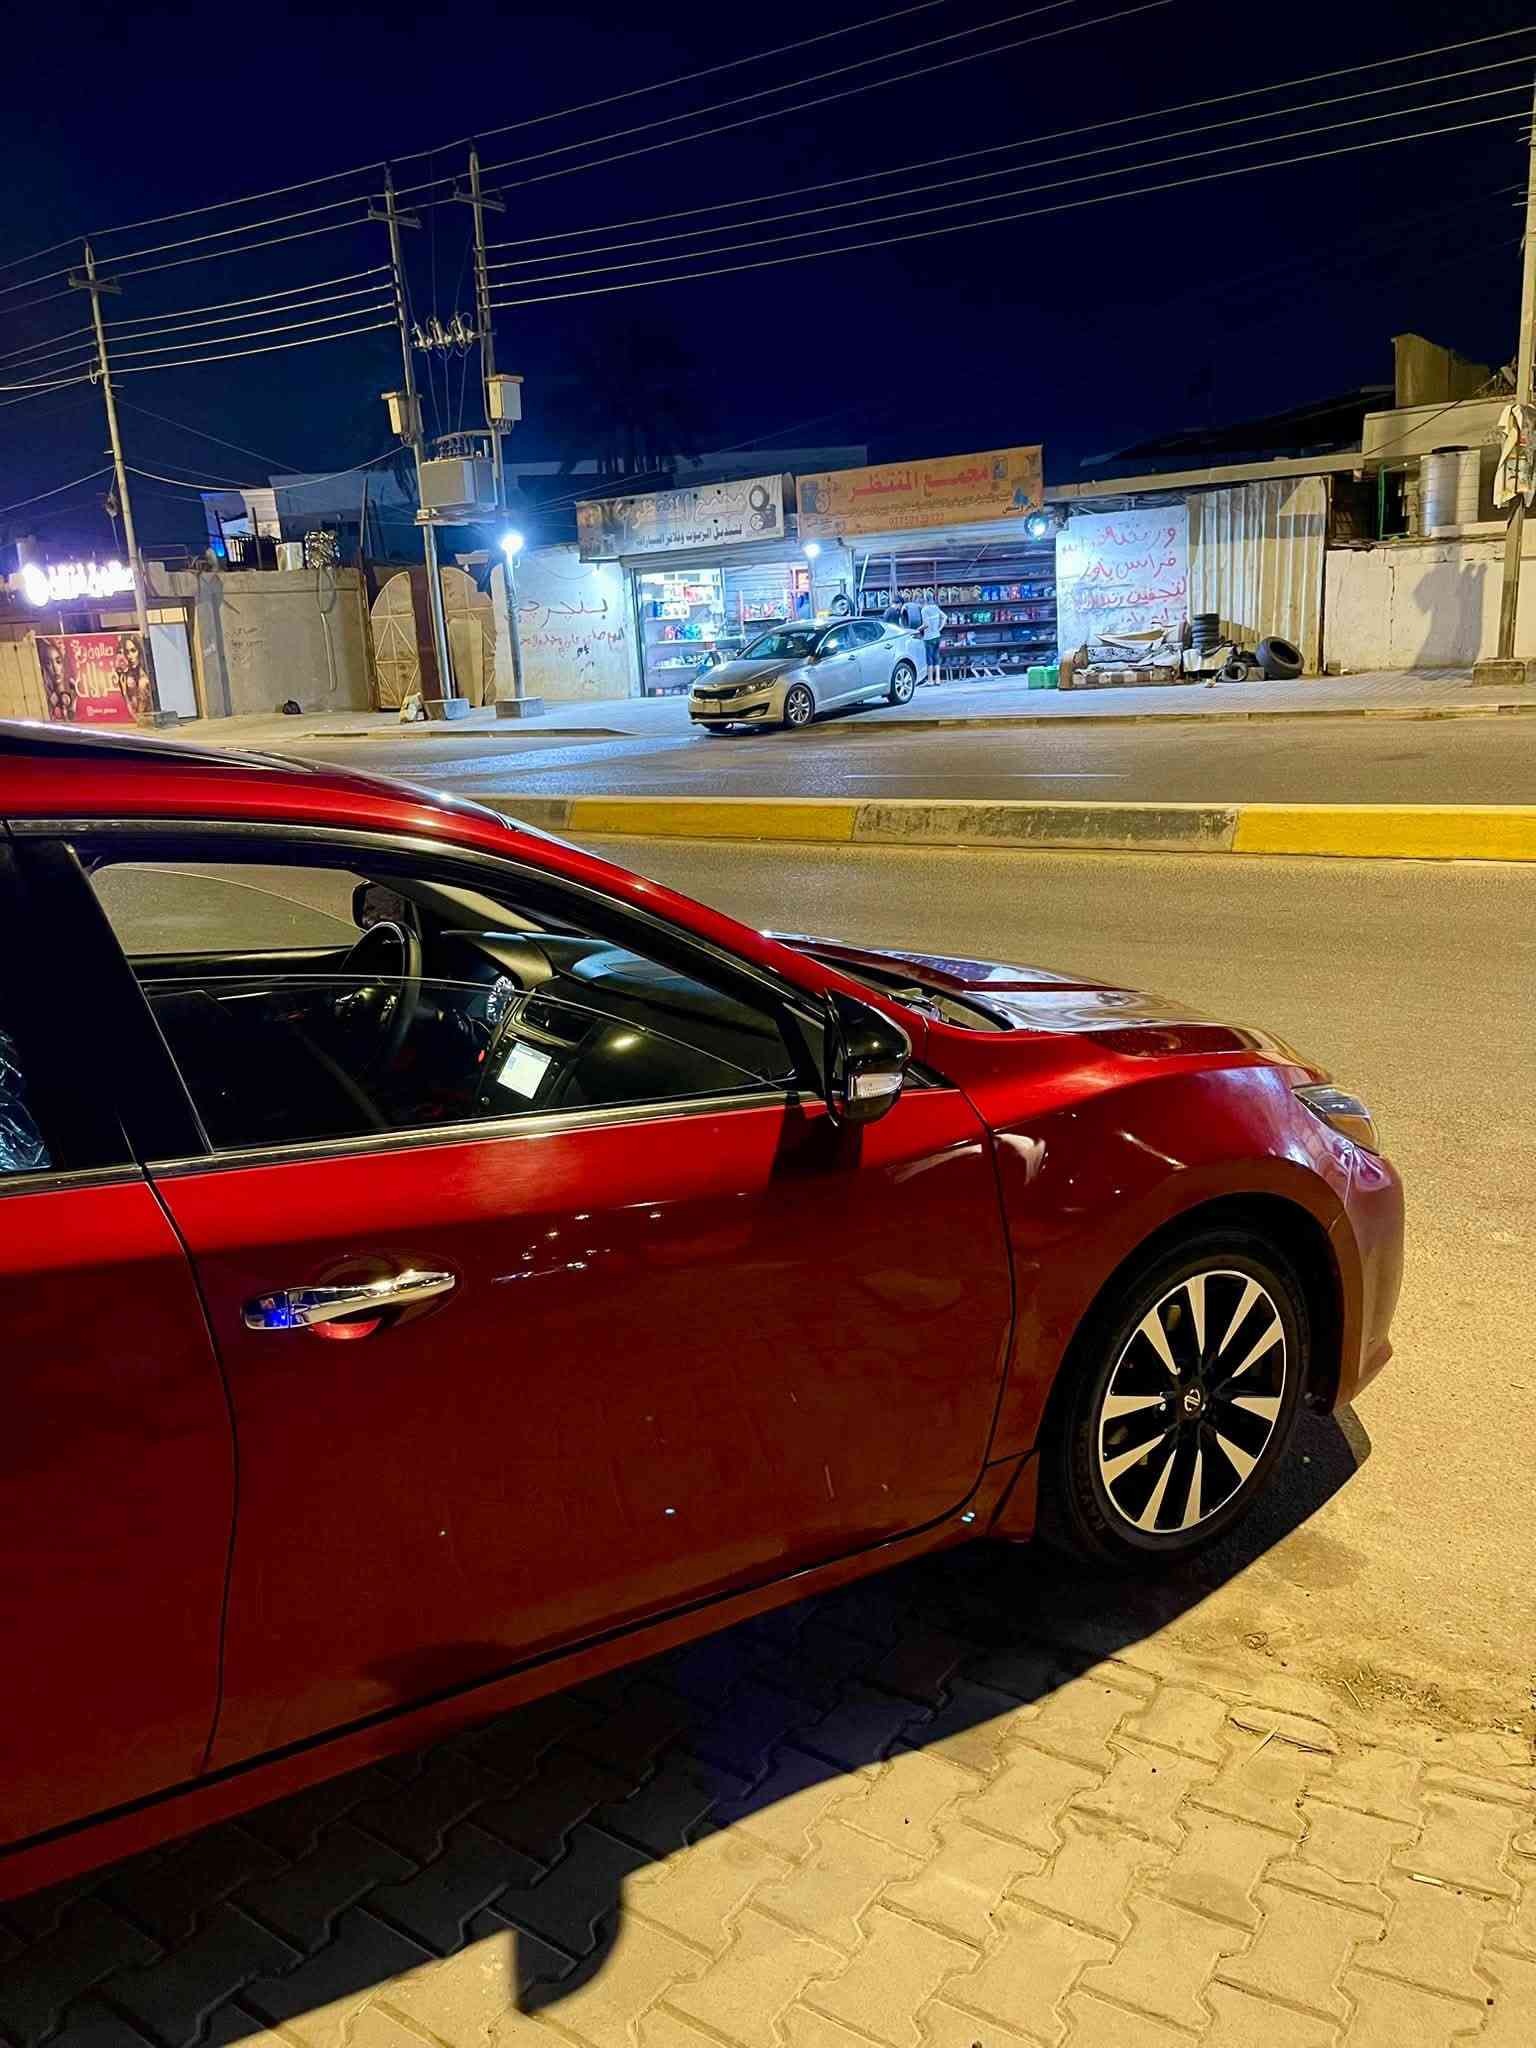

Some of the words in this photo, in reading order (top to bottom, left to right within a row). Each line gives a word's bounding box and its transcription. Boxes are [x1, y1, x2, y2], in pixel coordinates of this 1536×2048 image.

[848, 470, 919, 502] المنتظر
[921, 464, 989, 498] مجمع
[685, 528, 712, 545] الزيوت
